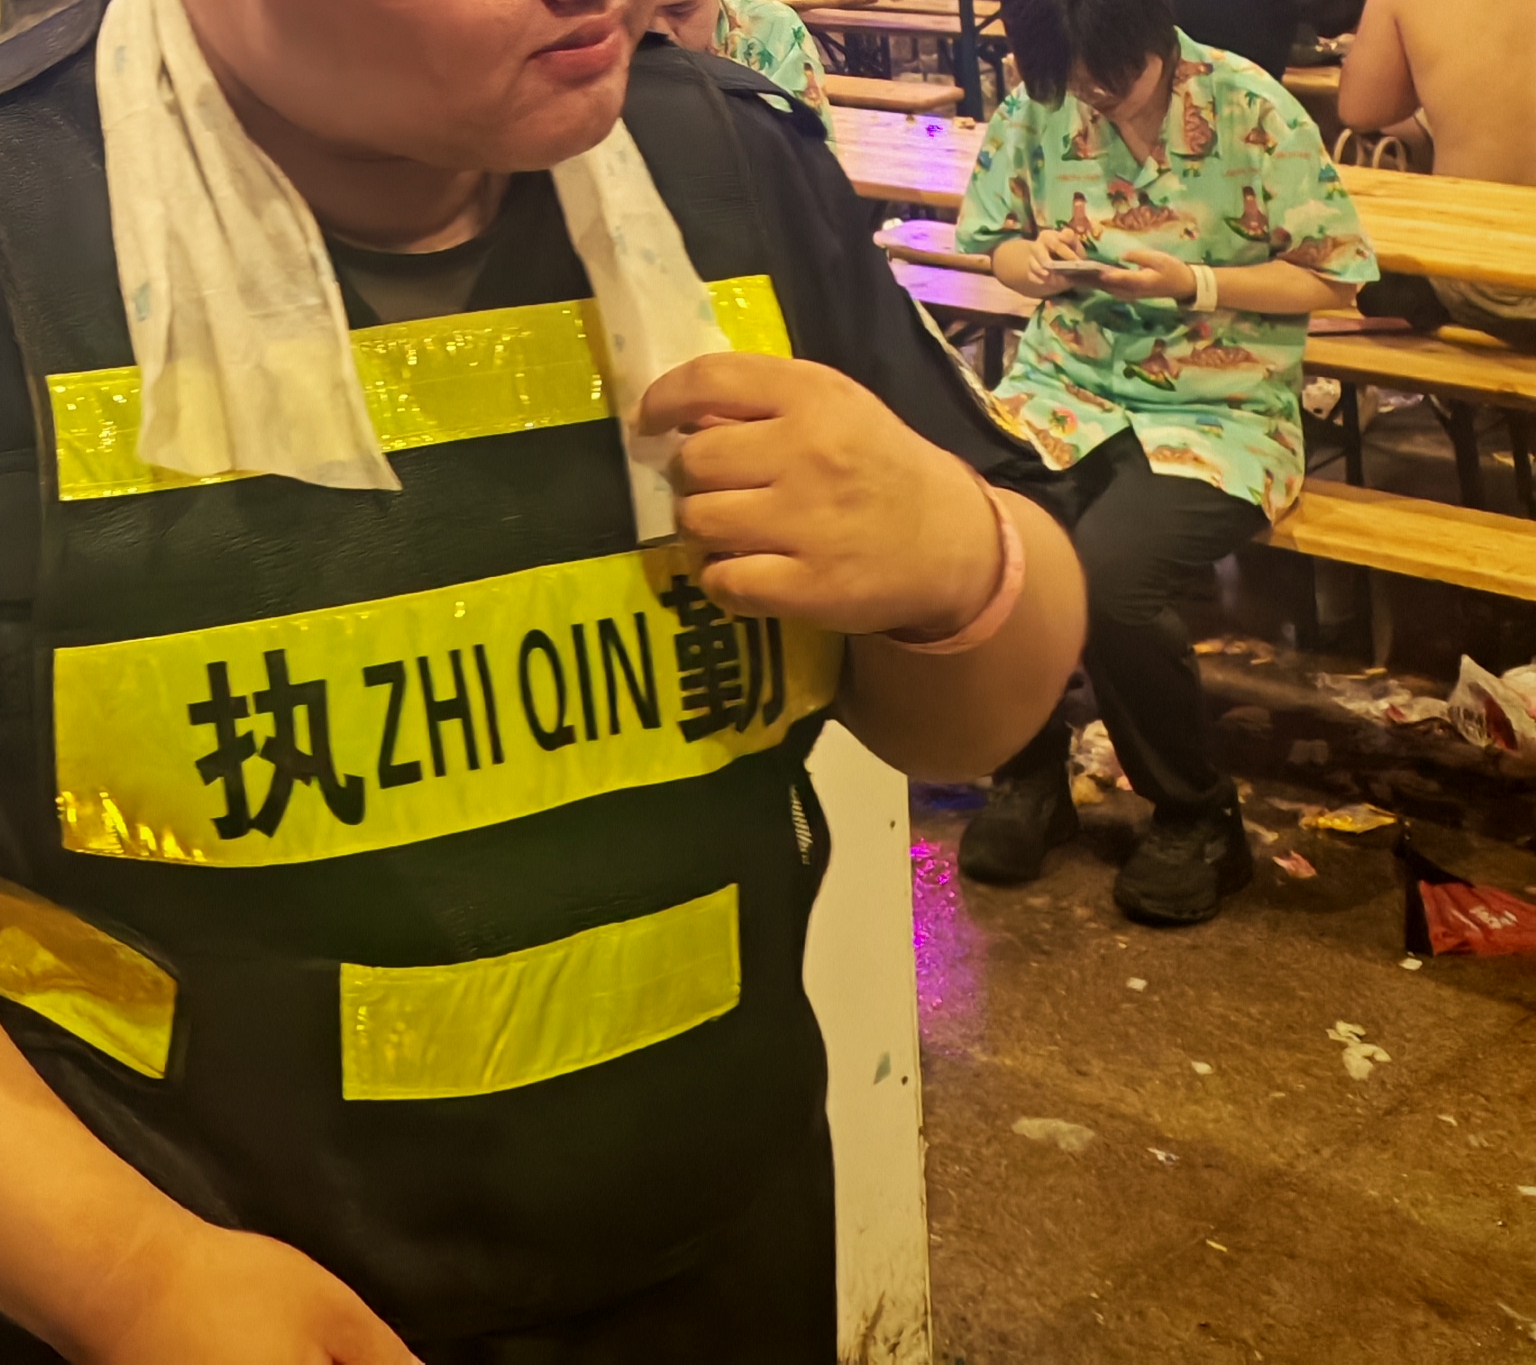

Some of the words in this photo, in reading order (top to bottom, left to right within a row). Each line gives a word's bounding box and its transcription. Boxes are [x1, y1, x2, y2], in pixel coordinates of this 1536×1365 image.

[187, 649, 366, 841] 执
[363, 643, 505, 790] ZHI
[518, 611, 661, 752] QIN
